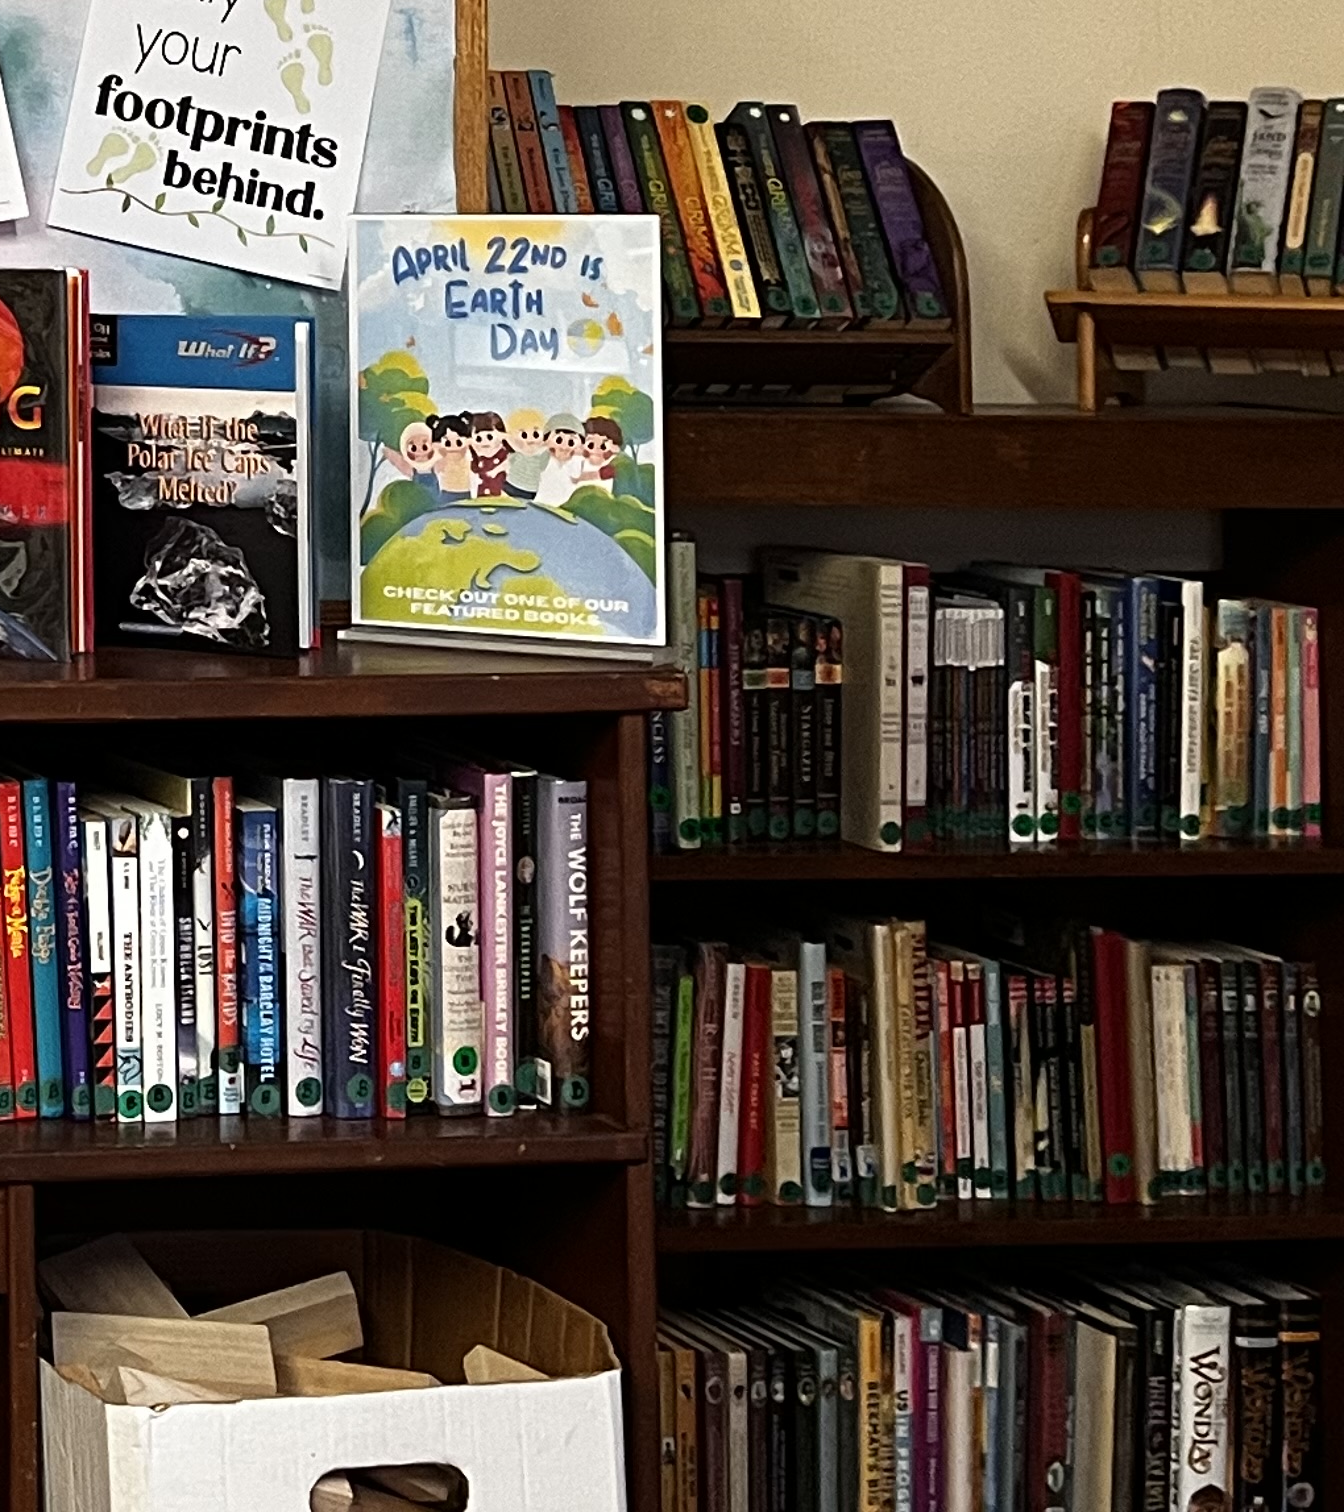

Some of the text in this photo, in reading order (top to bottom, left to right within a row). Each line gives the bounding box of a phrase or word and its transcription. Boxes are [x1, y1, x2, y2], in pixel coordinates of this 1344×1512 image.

[134, 21, 241, 78] your
[94, 74, 340, 170] footprints
[163, 150, 324, 222] behind.
[391, 236, 604, 286] APRIL 22ND IS
[444, 279, 543, 320] EARTH
[178, 337, 277, 360] What If?
[137, 414, 188, 438] What
[224, 417, 258, 442] the
[127, 443, 272, 480] Polar Ice Caps
[157, 476, 239, 505] Melted?
[383, 585, 629, 613] CHECK OUT ONE OF OUR
[410, 602, 600, 627] FEATURED BOOKS
[566, 813, 589, 1042] THE WOLF KEEPERS
